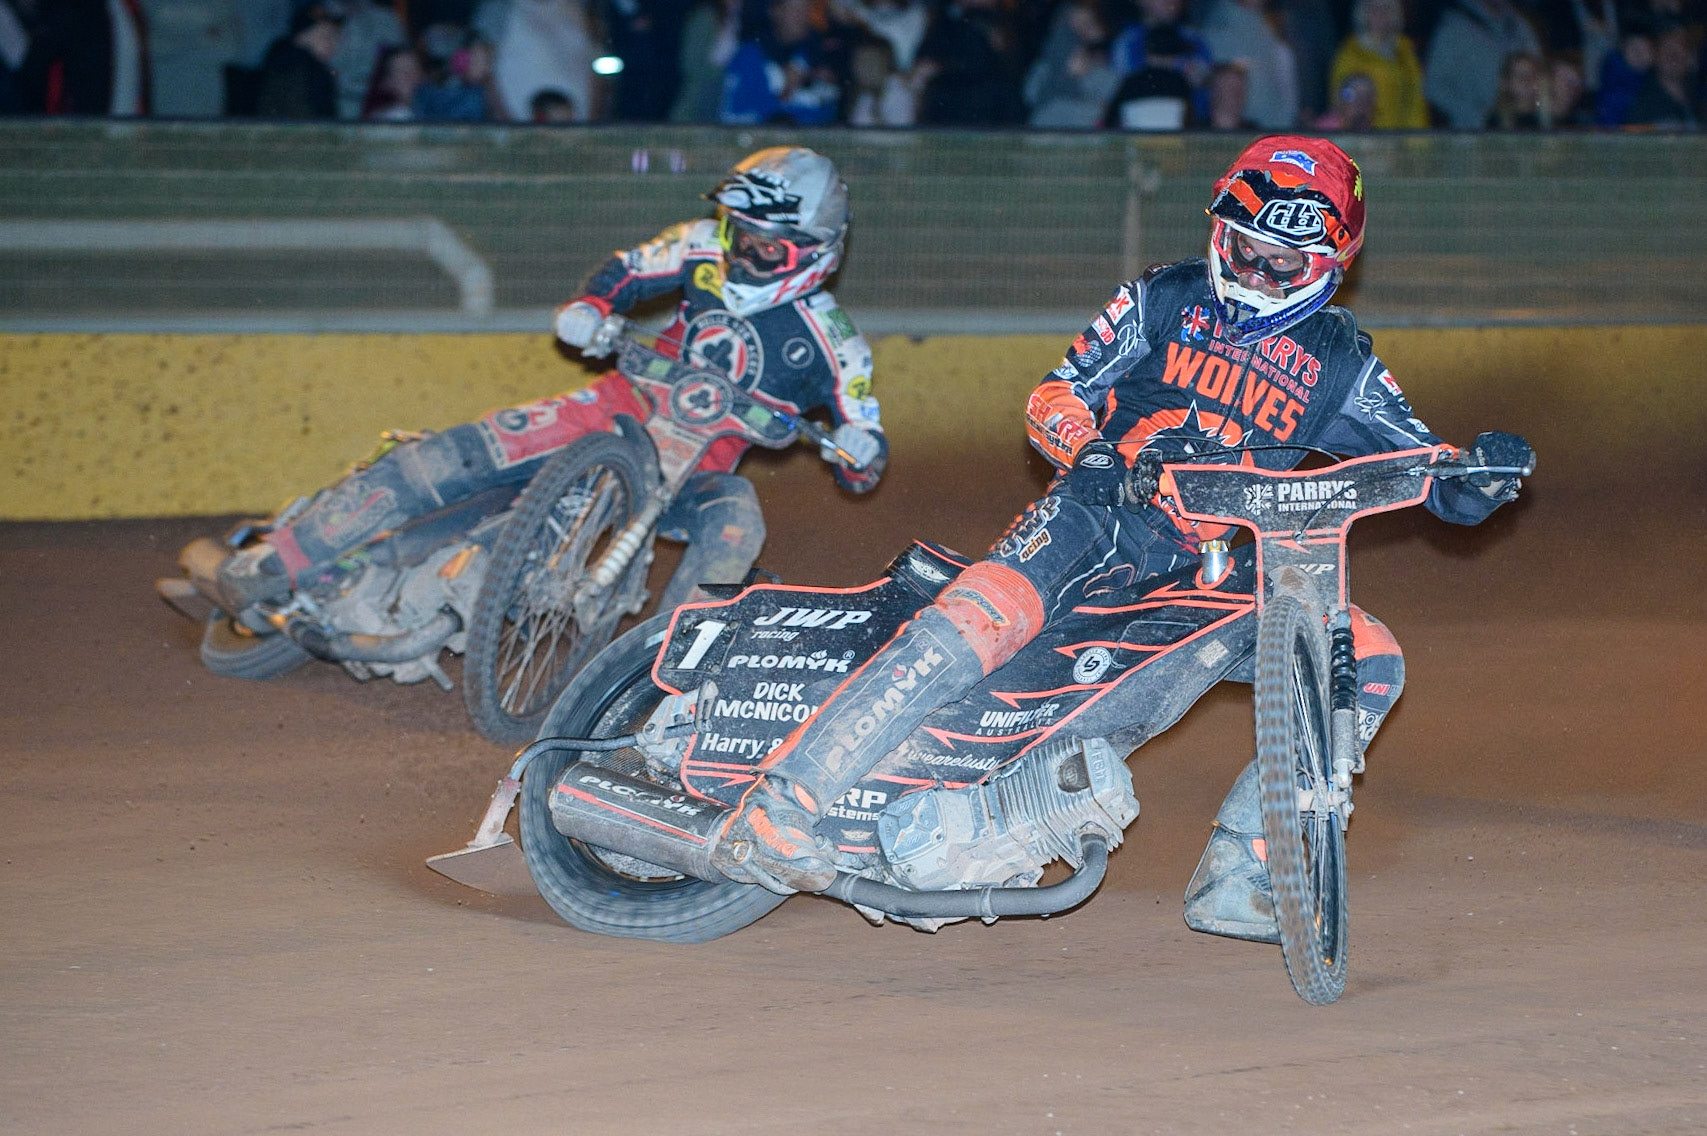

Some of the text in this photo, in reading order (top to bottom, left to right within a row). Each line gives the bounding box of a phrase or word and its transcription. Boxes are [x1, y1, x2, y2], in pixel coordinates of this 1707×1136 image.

[1162, 341, 1305, 442] WOLVES
[1277, 480, 1358, 501] PARRYS
[753, 606, 872, 630] JWP
[677, 620, 726, 670] 1
[751, 628, 800, 642] racing
[753, 681, 805, 701] DICK
[701, 732, 765, 759] Harry
[826, 808, 880, 822] stems
